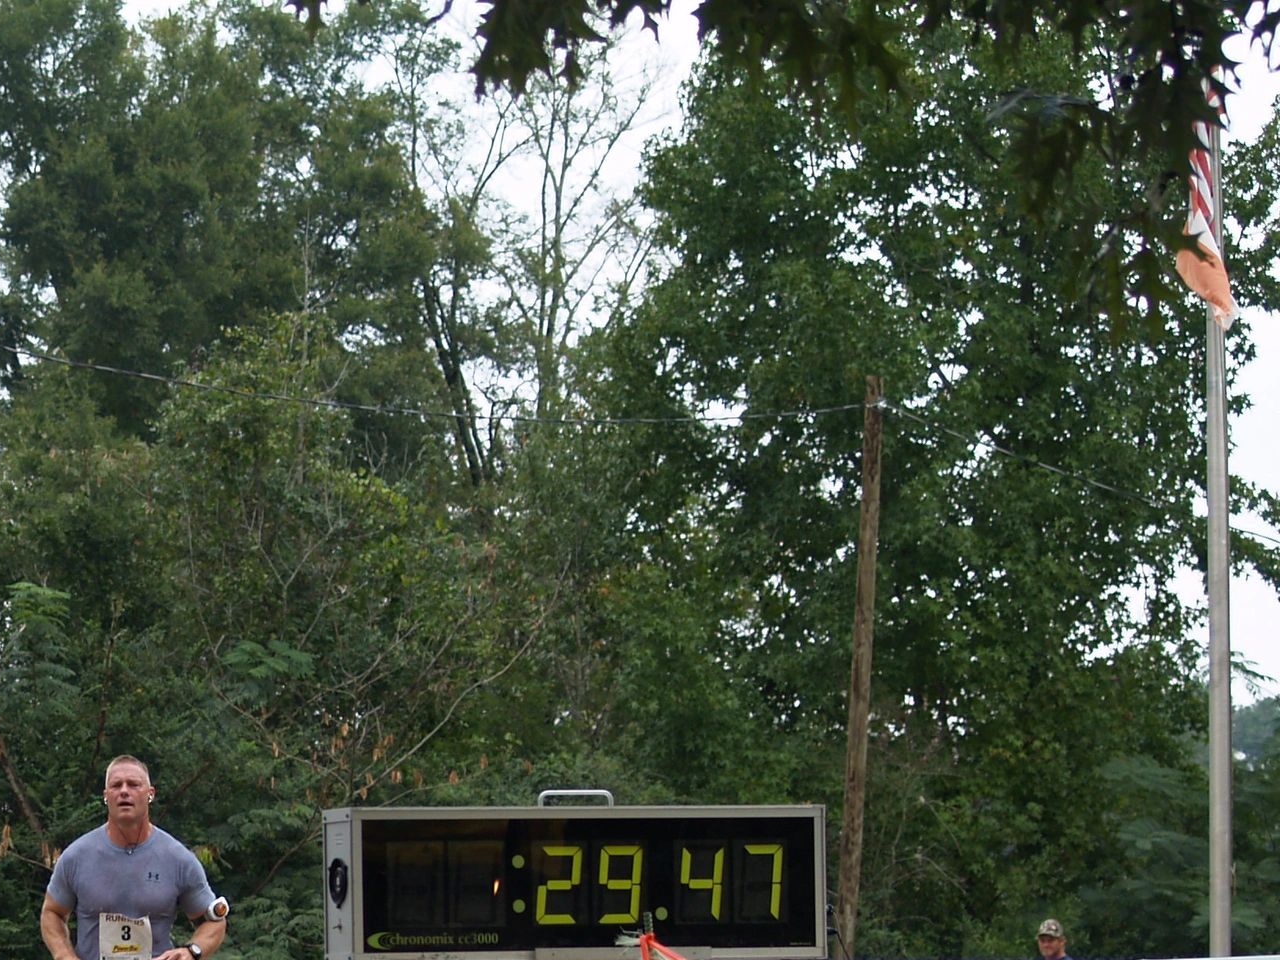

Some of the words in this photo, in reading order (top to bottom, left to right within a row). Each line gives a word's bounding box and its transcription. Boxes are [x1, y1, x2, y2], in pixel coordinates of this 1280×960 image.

[121, 925, 131, 941] 3
[389, 932, 455, 945] chronomix
[458, 933, 499, 945] cc3000
